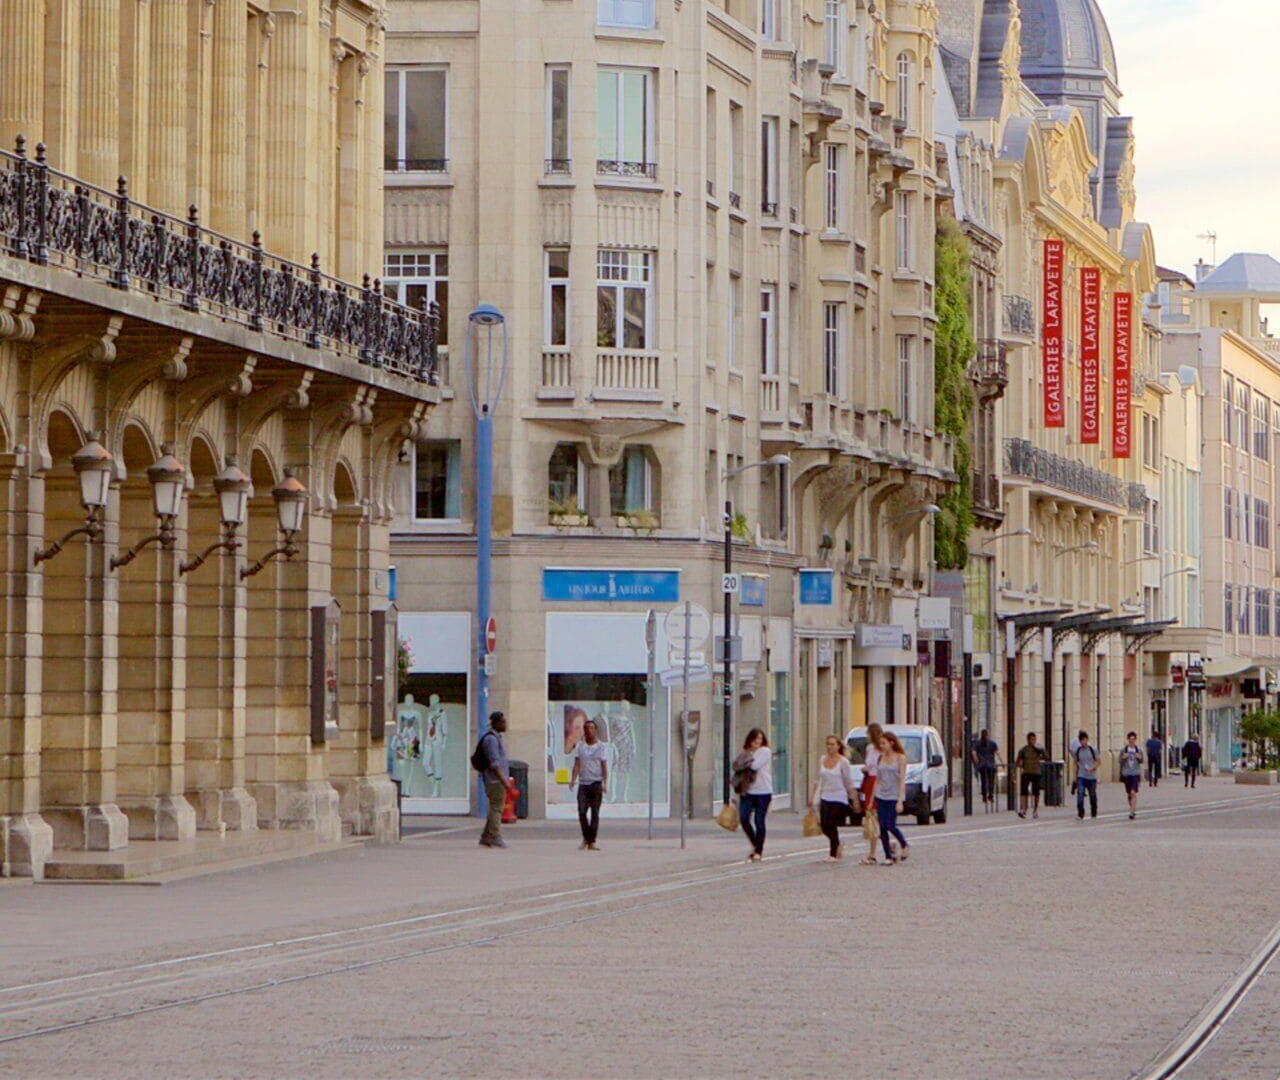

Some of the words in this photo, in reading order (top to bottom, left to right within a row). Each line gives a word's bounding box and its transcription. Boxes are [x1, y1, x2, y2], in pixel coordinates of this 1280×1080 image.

[1047, 244, 1061, 328] LAFAYETTE
[1084, 271, 1097, 350] LAFAYETTE
[1117, 297, 1129, 371] LAFAYETTE
[1047, 337, 1060, 413] GALERIES
[1084, 358, 1097, 430] GALERIES
[1115, 378, 1128, 446] GALERIES
[723, 576, 737, 590] 20
